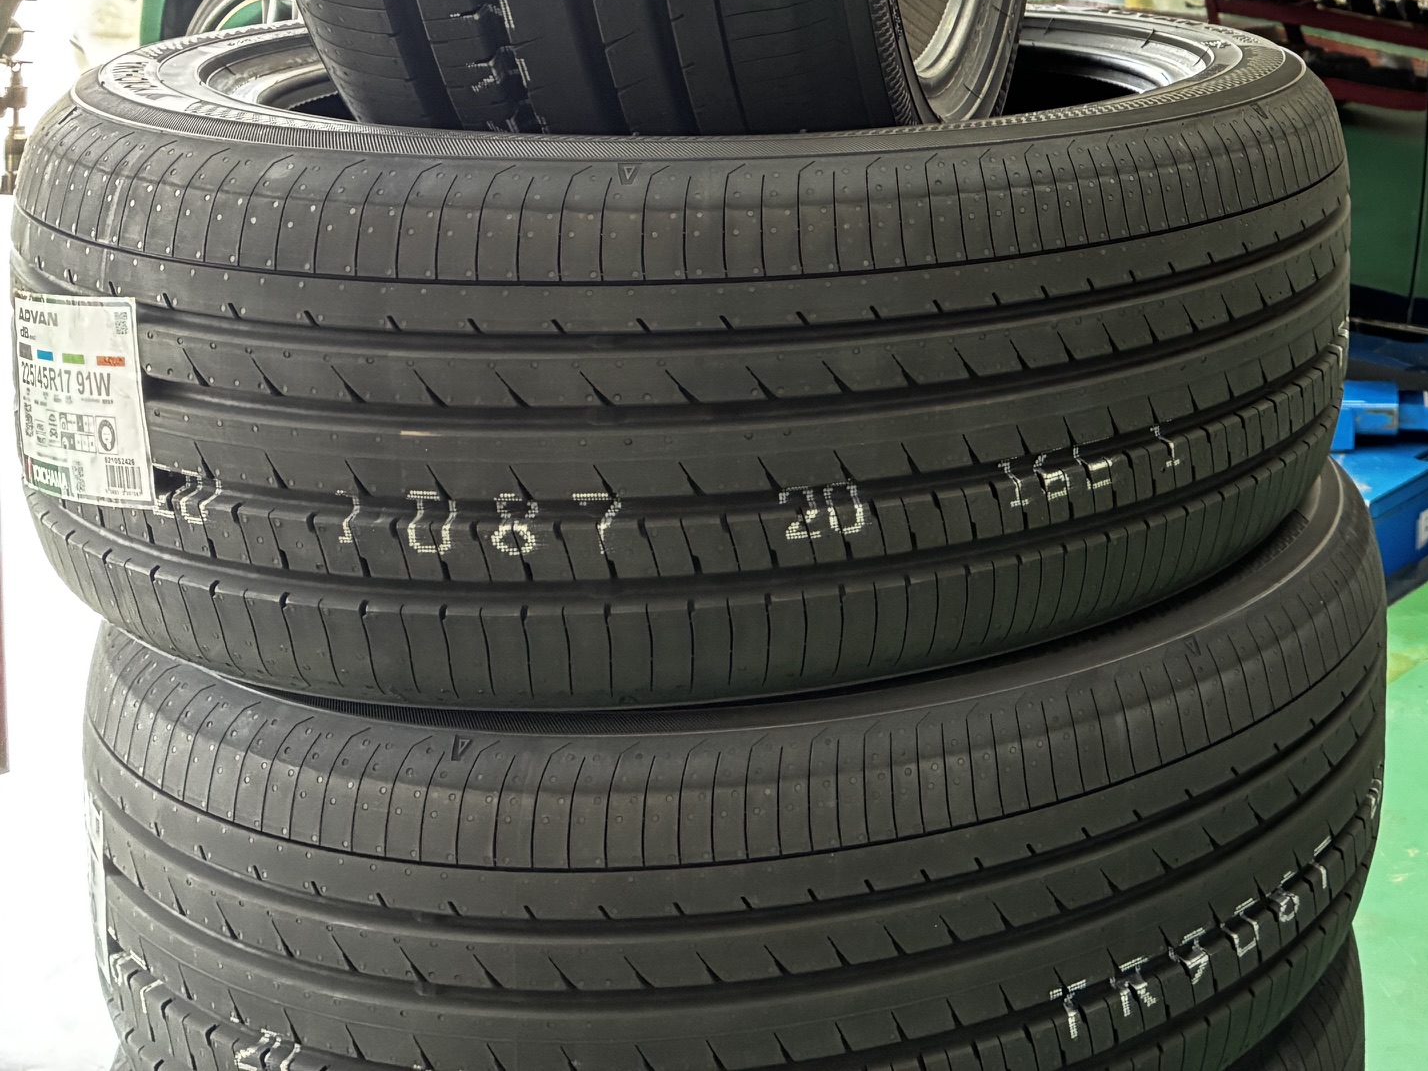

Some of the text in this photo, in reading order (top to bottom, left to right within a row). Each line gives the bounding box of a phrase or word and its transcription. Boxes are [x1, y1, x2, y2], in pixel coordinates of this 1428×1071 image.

[18, 307, 60, 327] ADVAN
[20, 361, 112, 397] 225/45R17 91W
